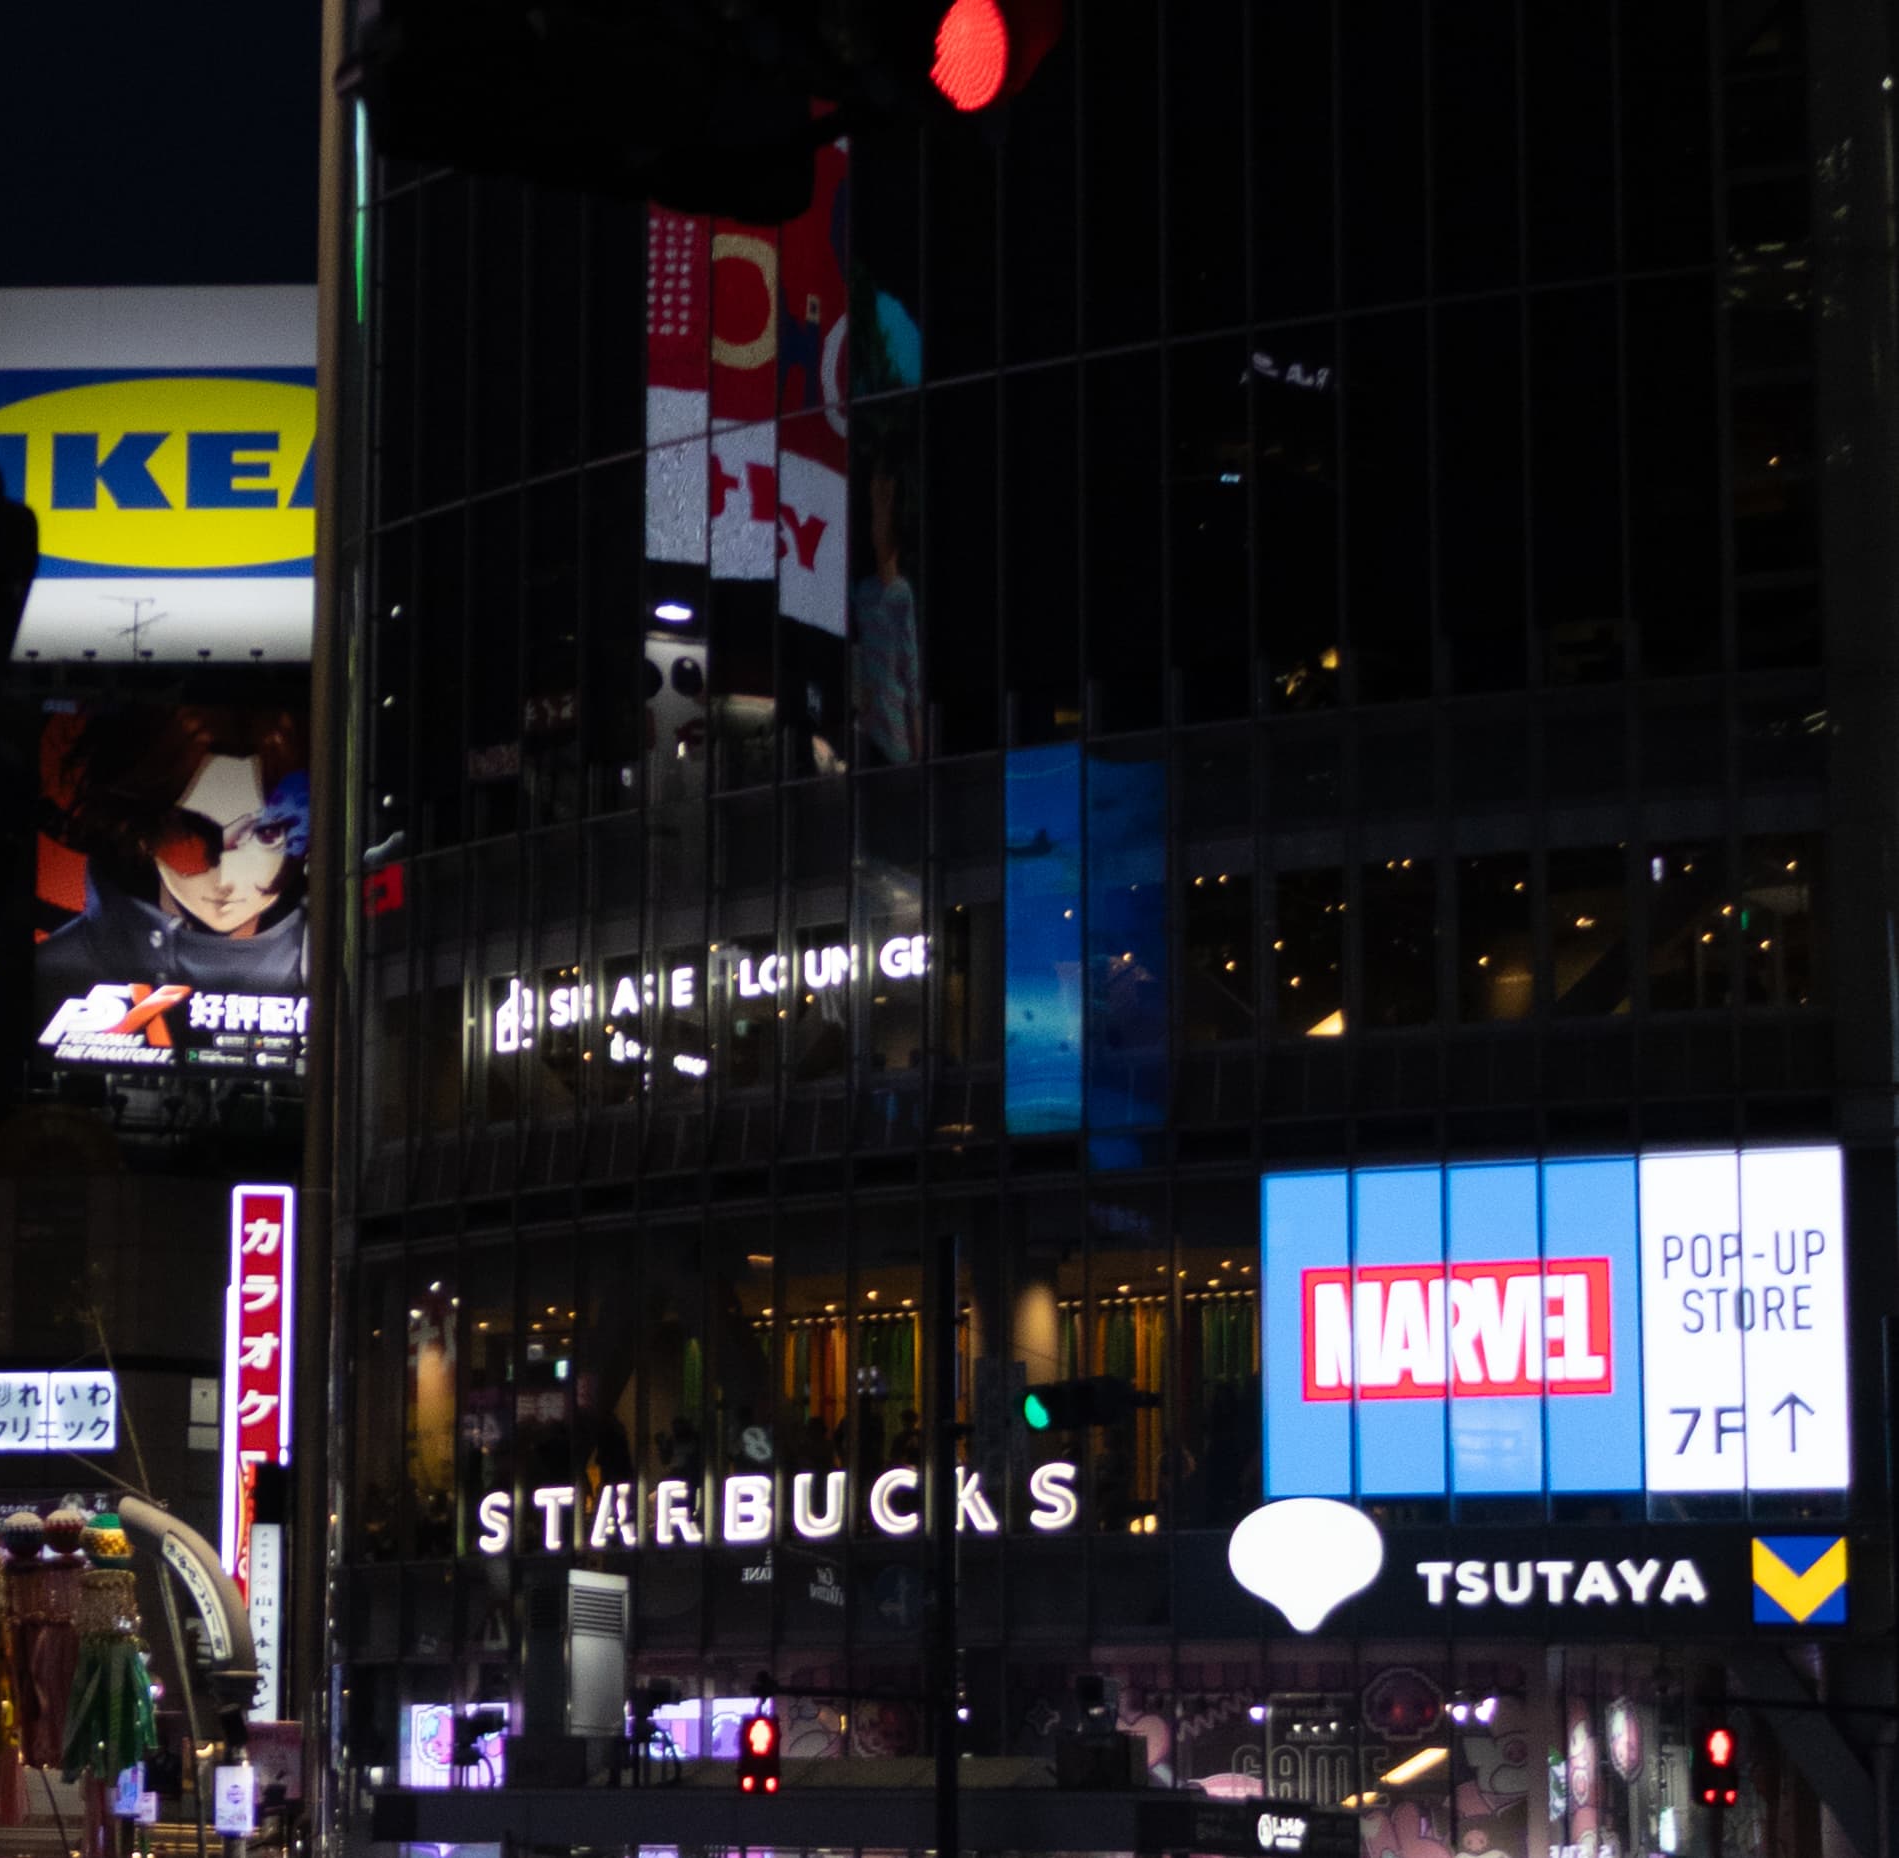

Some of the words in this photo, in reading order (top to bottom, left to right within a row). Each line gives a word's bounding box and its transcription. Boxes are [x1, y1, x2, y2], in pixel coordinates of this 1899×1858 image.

[1663, 1229, 1826, 1280] POP-UP
[1313, 1272, 1607, 1389] MARVEL
[1682, 1286, 1813, 1334] STORE
[19, 1382, 112, 1409] れいわ
[1669, 1406, 1746, 1456] 7F
[477, 1461, 1082, 1554] STARBUCKS
[1416, 1558, 1707, 1605] TSUTAYA
